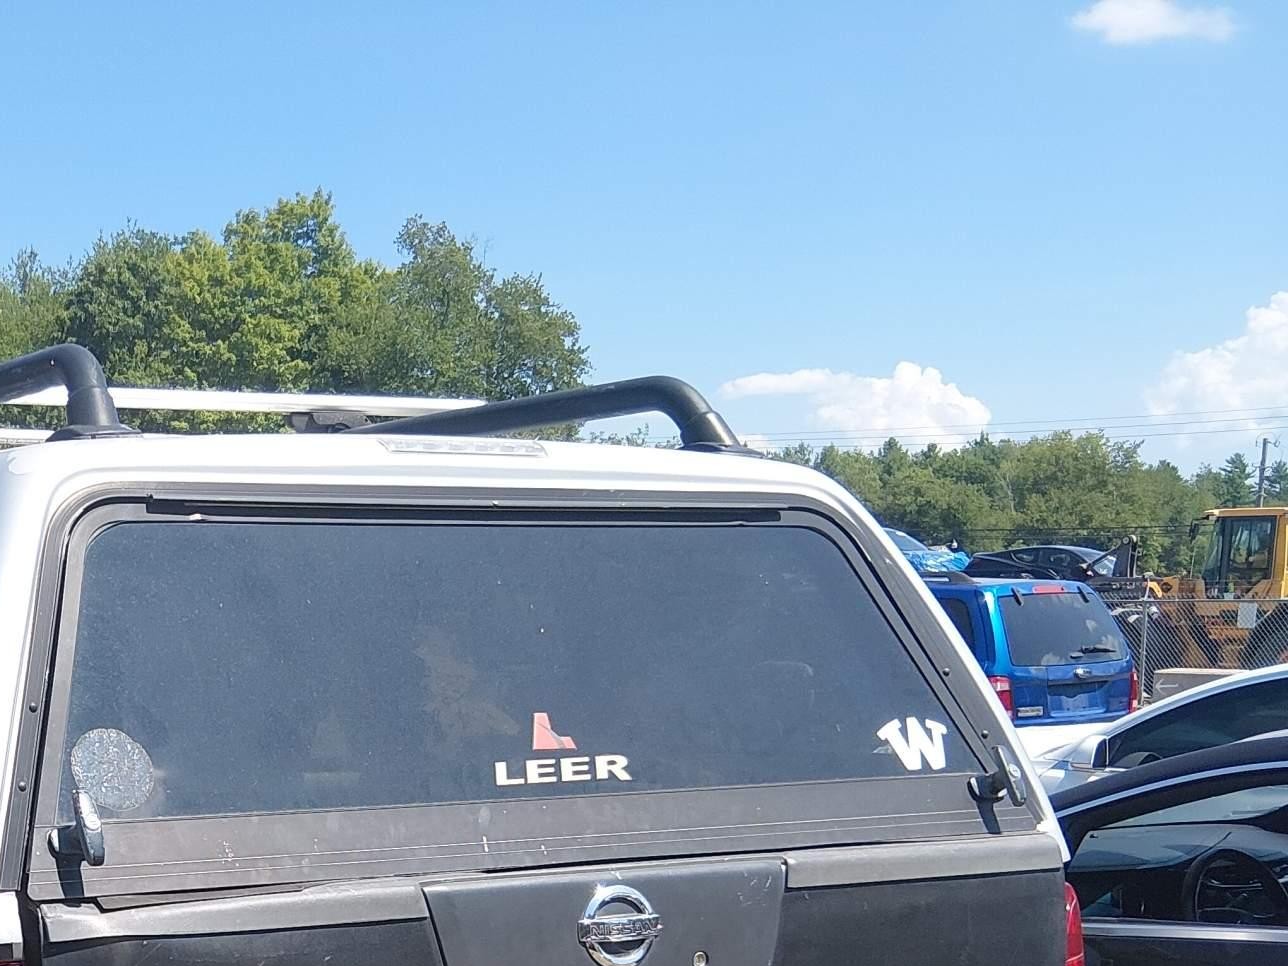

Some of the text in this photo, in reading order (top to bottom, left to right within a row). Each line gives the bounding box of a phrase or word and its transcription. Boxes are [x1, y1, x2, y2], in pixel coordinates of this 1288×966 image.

[875, 716, 948, 771] W
[494, 755, 632, 787] LEER
[588, 919, 661, 938] NISSAN
